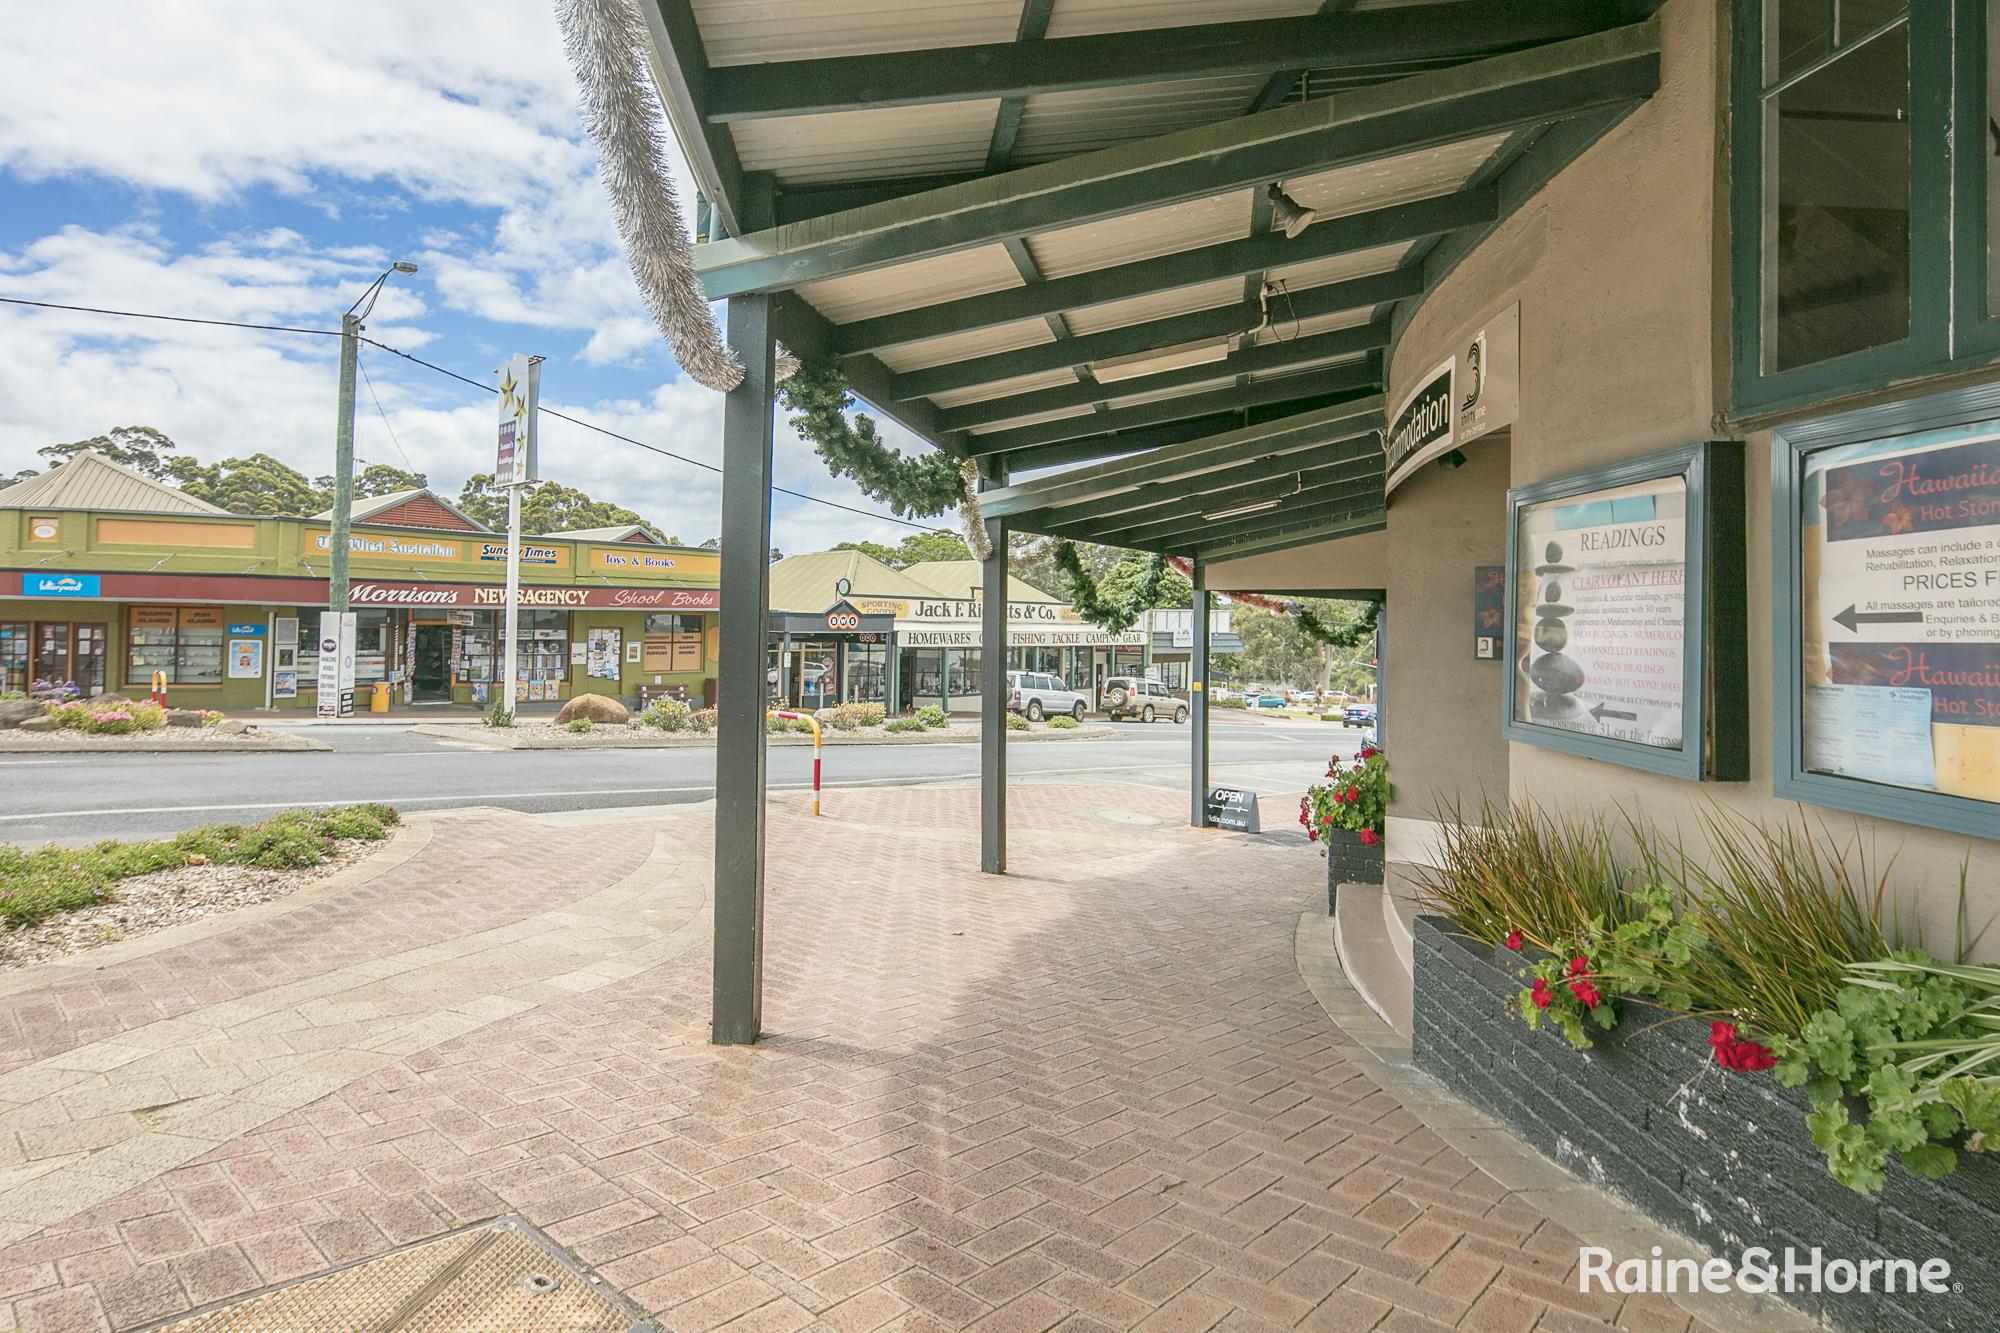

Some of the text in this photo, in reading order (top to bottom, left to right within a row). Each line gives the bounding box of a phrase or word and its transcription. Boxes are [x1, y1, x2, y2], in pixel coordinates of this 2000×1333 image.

[1920, 504, 1952, 520] Hot
[1580, 525, 1665, 551] READINGS
[525, 547, 557, 558] Times
[1866, 540, 1993, 560] Massages can include a
[631, 557, 639, 566] &
[645, 557, 674, 568] Books
[1904, 571, 1977, 591] PRICES
[349, 584, 458, 603] Morrison's
[609, 590, 713, 606] School Books
[915, 601, 952, 618] Jack
[1024, 604, 1036, 619] &
[1865, 601, 1878, 611] All
[1880, 600, 1934, 611] massages
[1937, 600, 1955, 609] are
[1926, 614, 1973, 626] Enquiries
[1979, 614, 1987, 624] &
[908, 632, 972, 645] HOMEWARES
[1012, 633, 1046, 645] FISHING
[1052, 633, 1081, 644] TACKLE
[1123, 632, 1142, 643] GEAR
[1926, 628, 2000, 640] or by phoning
[1935, 697, 1968, 714] Hot
[1215, 790, 1244, 803] OPEN
